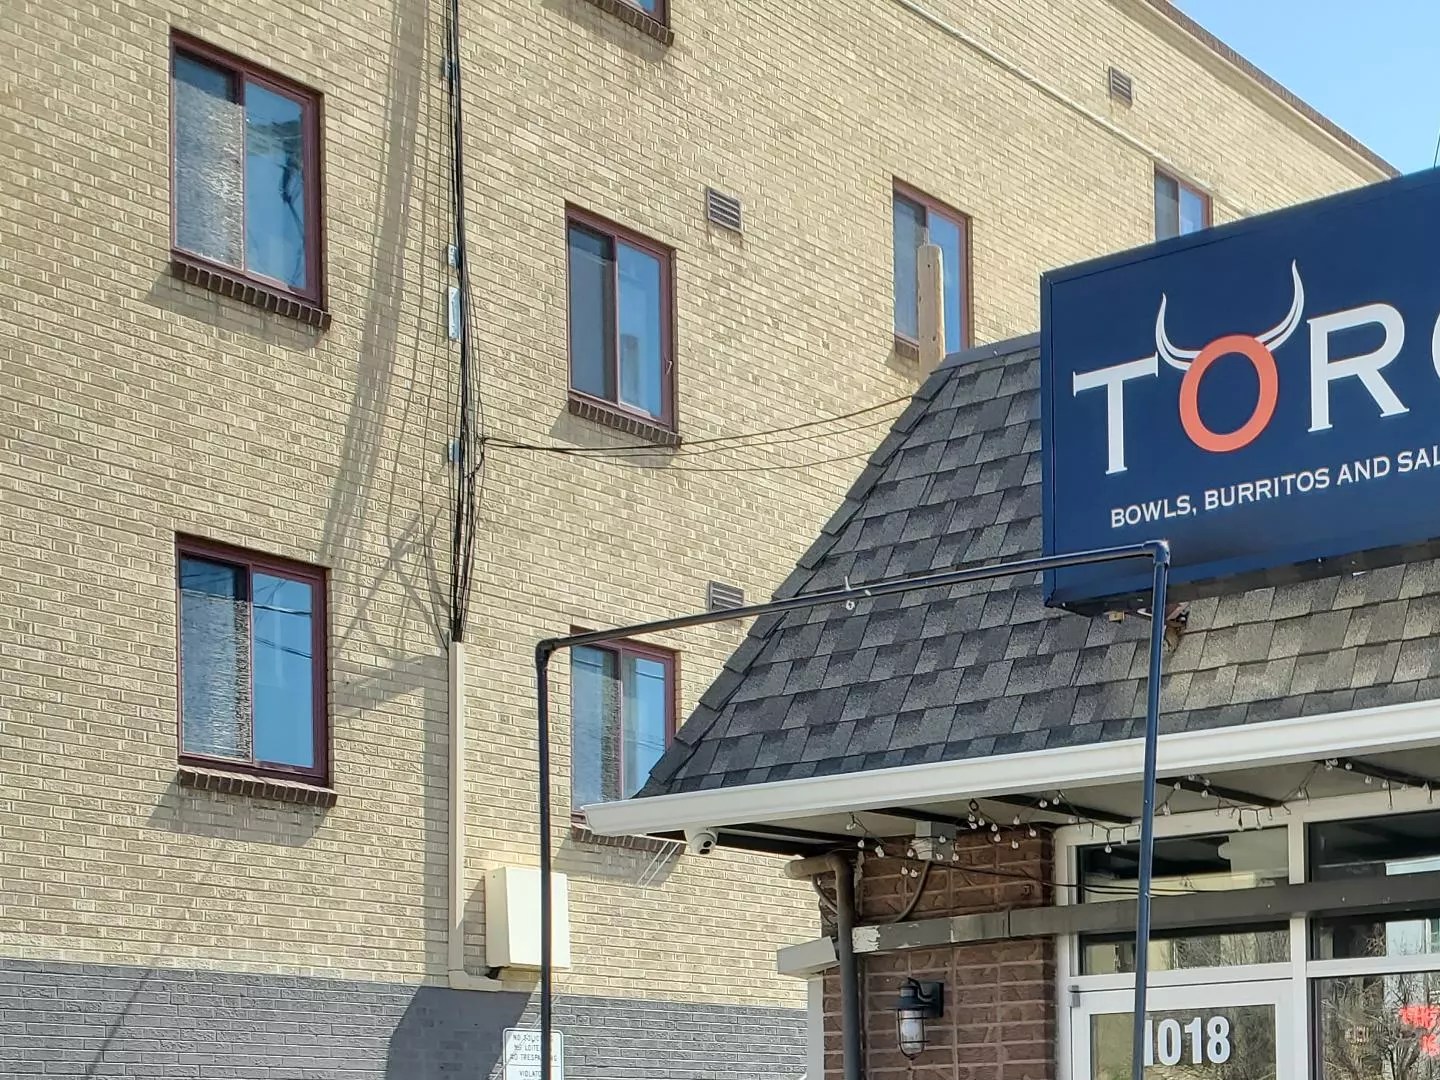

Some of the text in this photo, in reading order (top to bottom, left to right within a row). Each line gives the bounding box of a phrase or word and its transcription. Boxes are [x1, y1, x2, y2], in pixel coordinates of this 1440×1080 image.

[1110, 494, 1198, 529] BOWLS,
[1204, 466, 1331, 511] BURRITOS
[1337, 455, 1391, 485] AND
[1144, 1015, 1231, 1067] 1018
